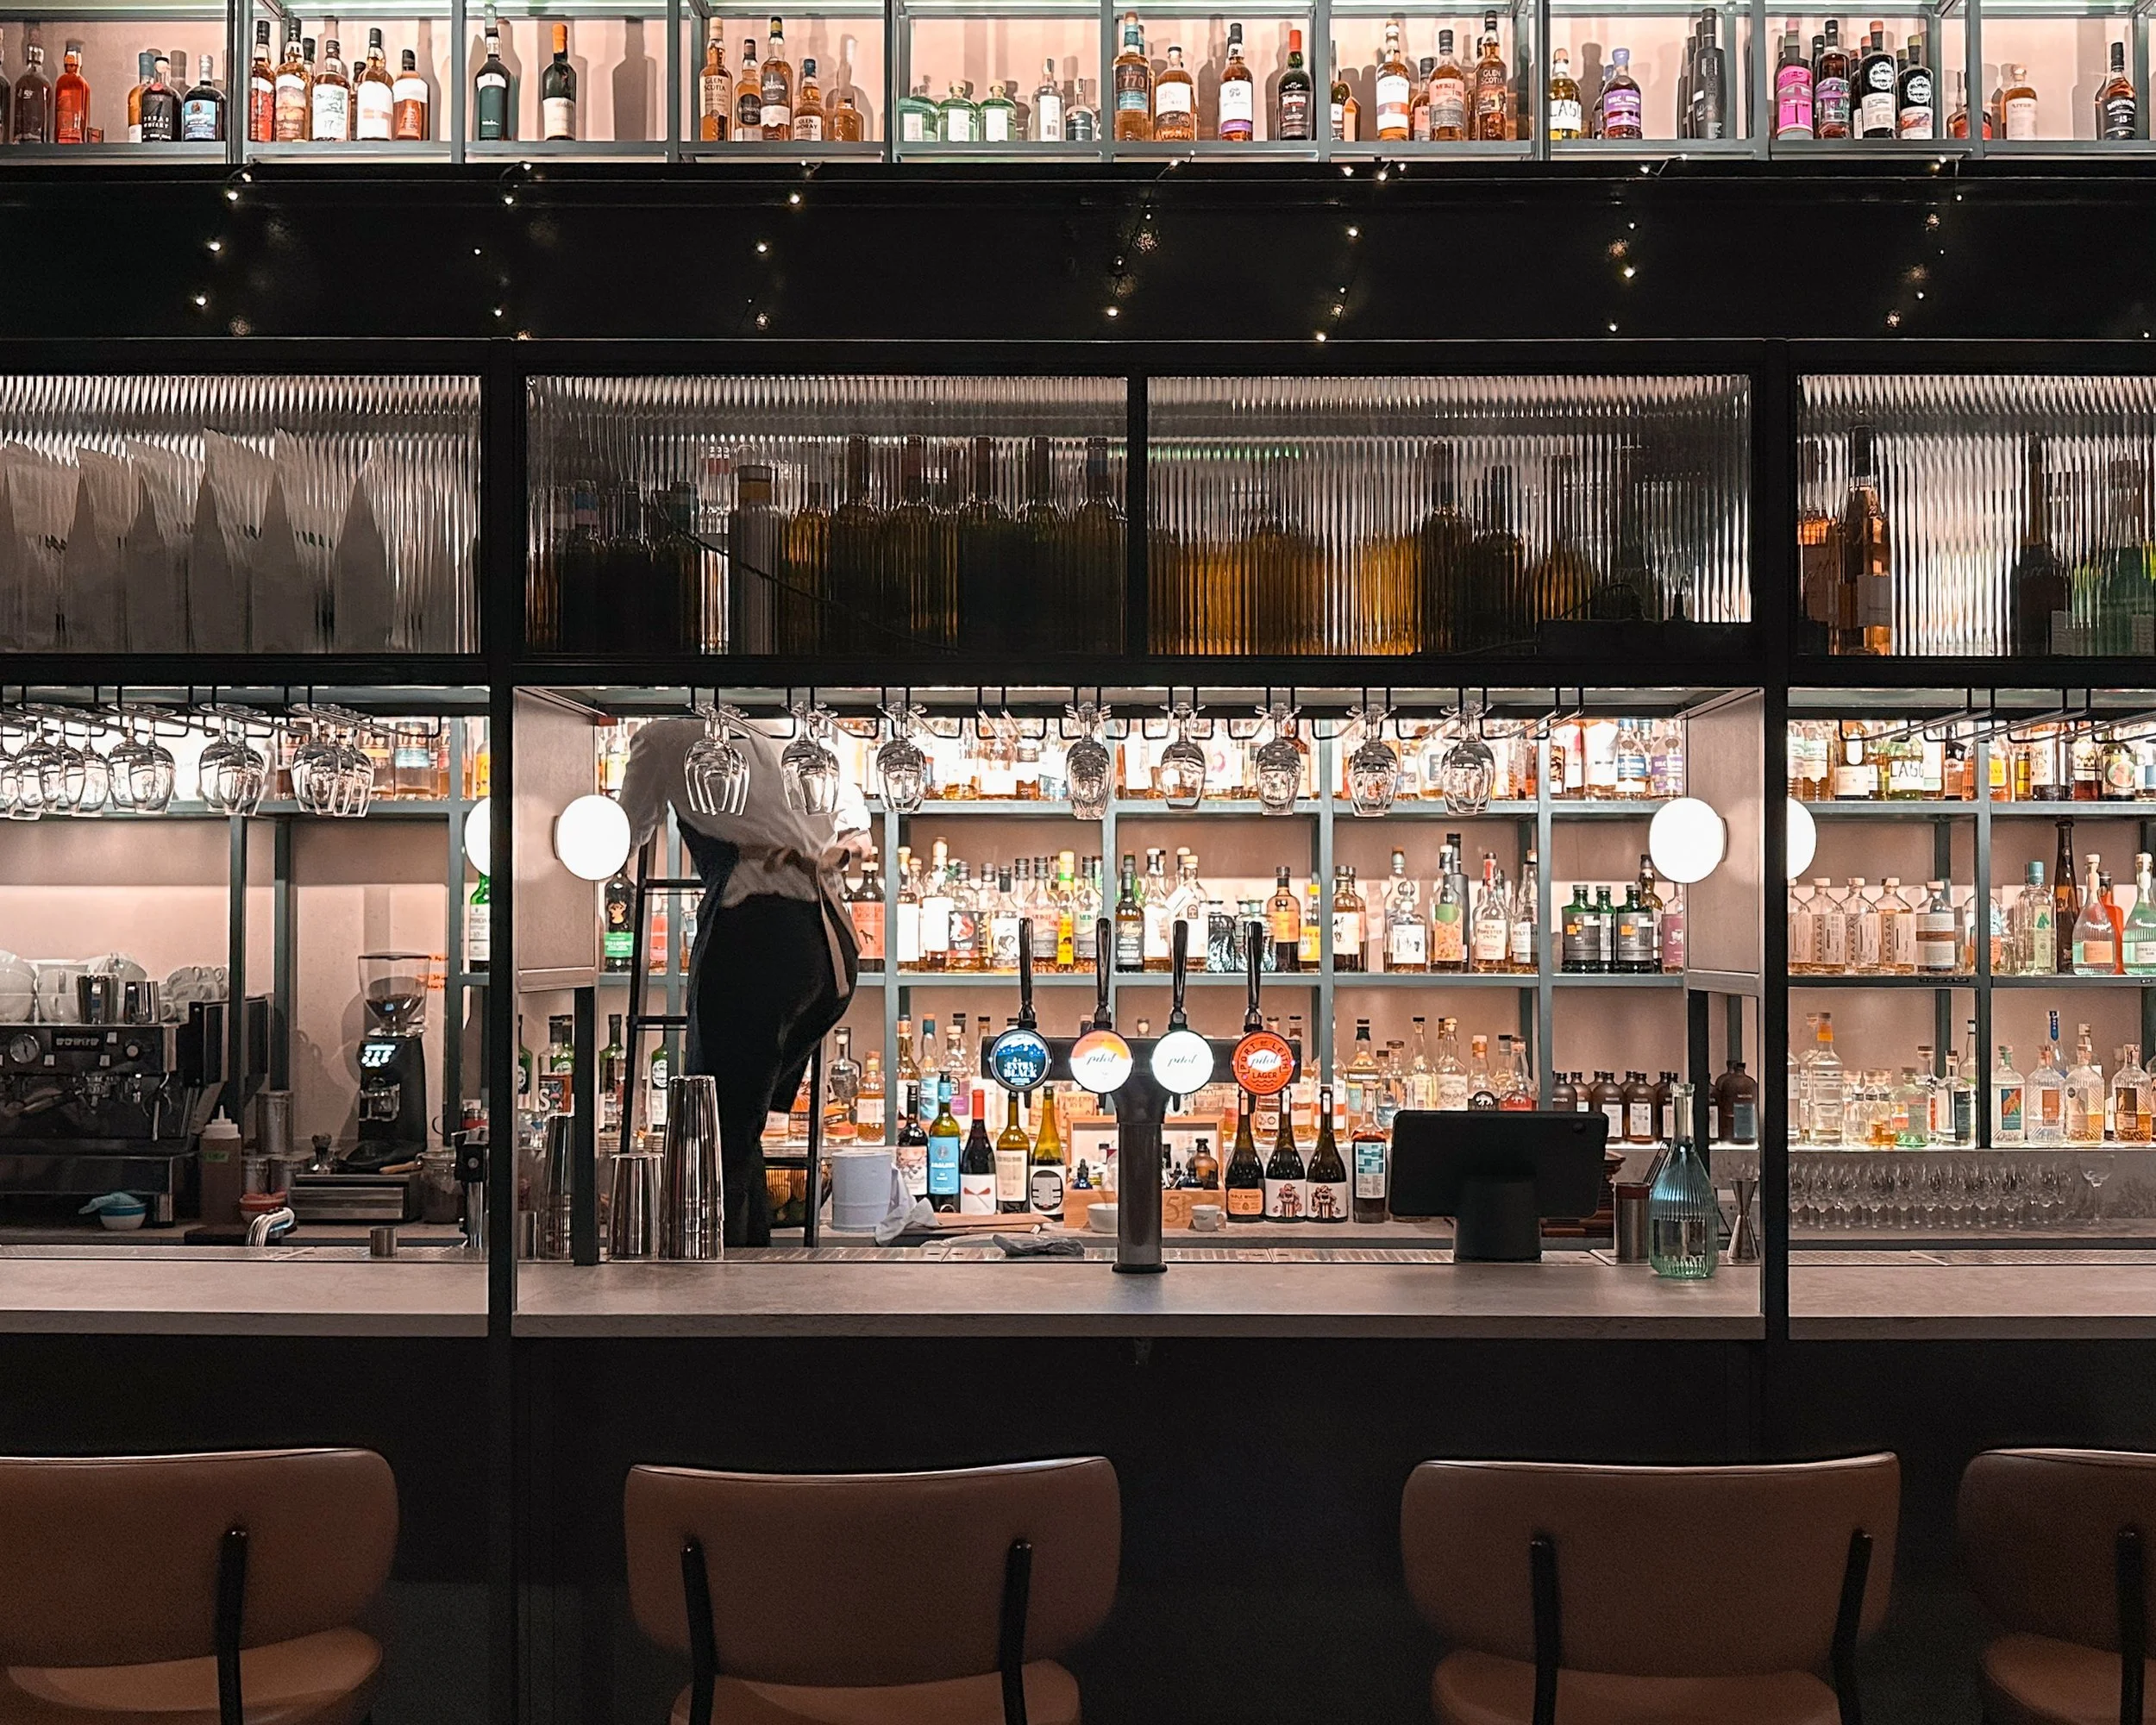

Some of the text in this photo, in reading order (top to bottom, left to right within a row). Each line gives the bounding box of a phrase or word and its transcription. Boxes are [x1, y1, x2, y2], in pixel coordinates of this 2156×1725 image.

[1118, 75, 1144, 88] 1770
[1239, 1043, 1256, 1071] PORT
[1271, 1042, 1289, 1070] LEITH
[1003, 1069, 1037, 1078] BLACK
